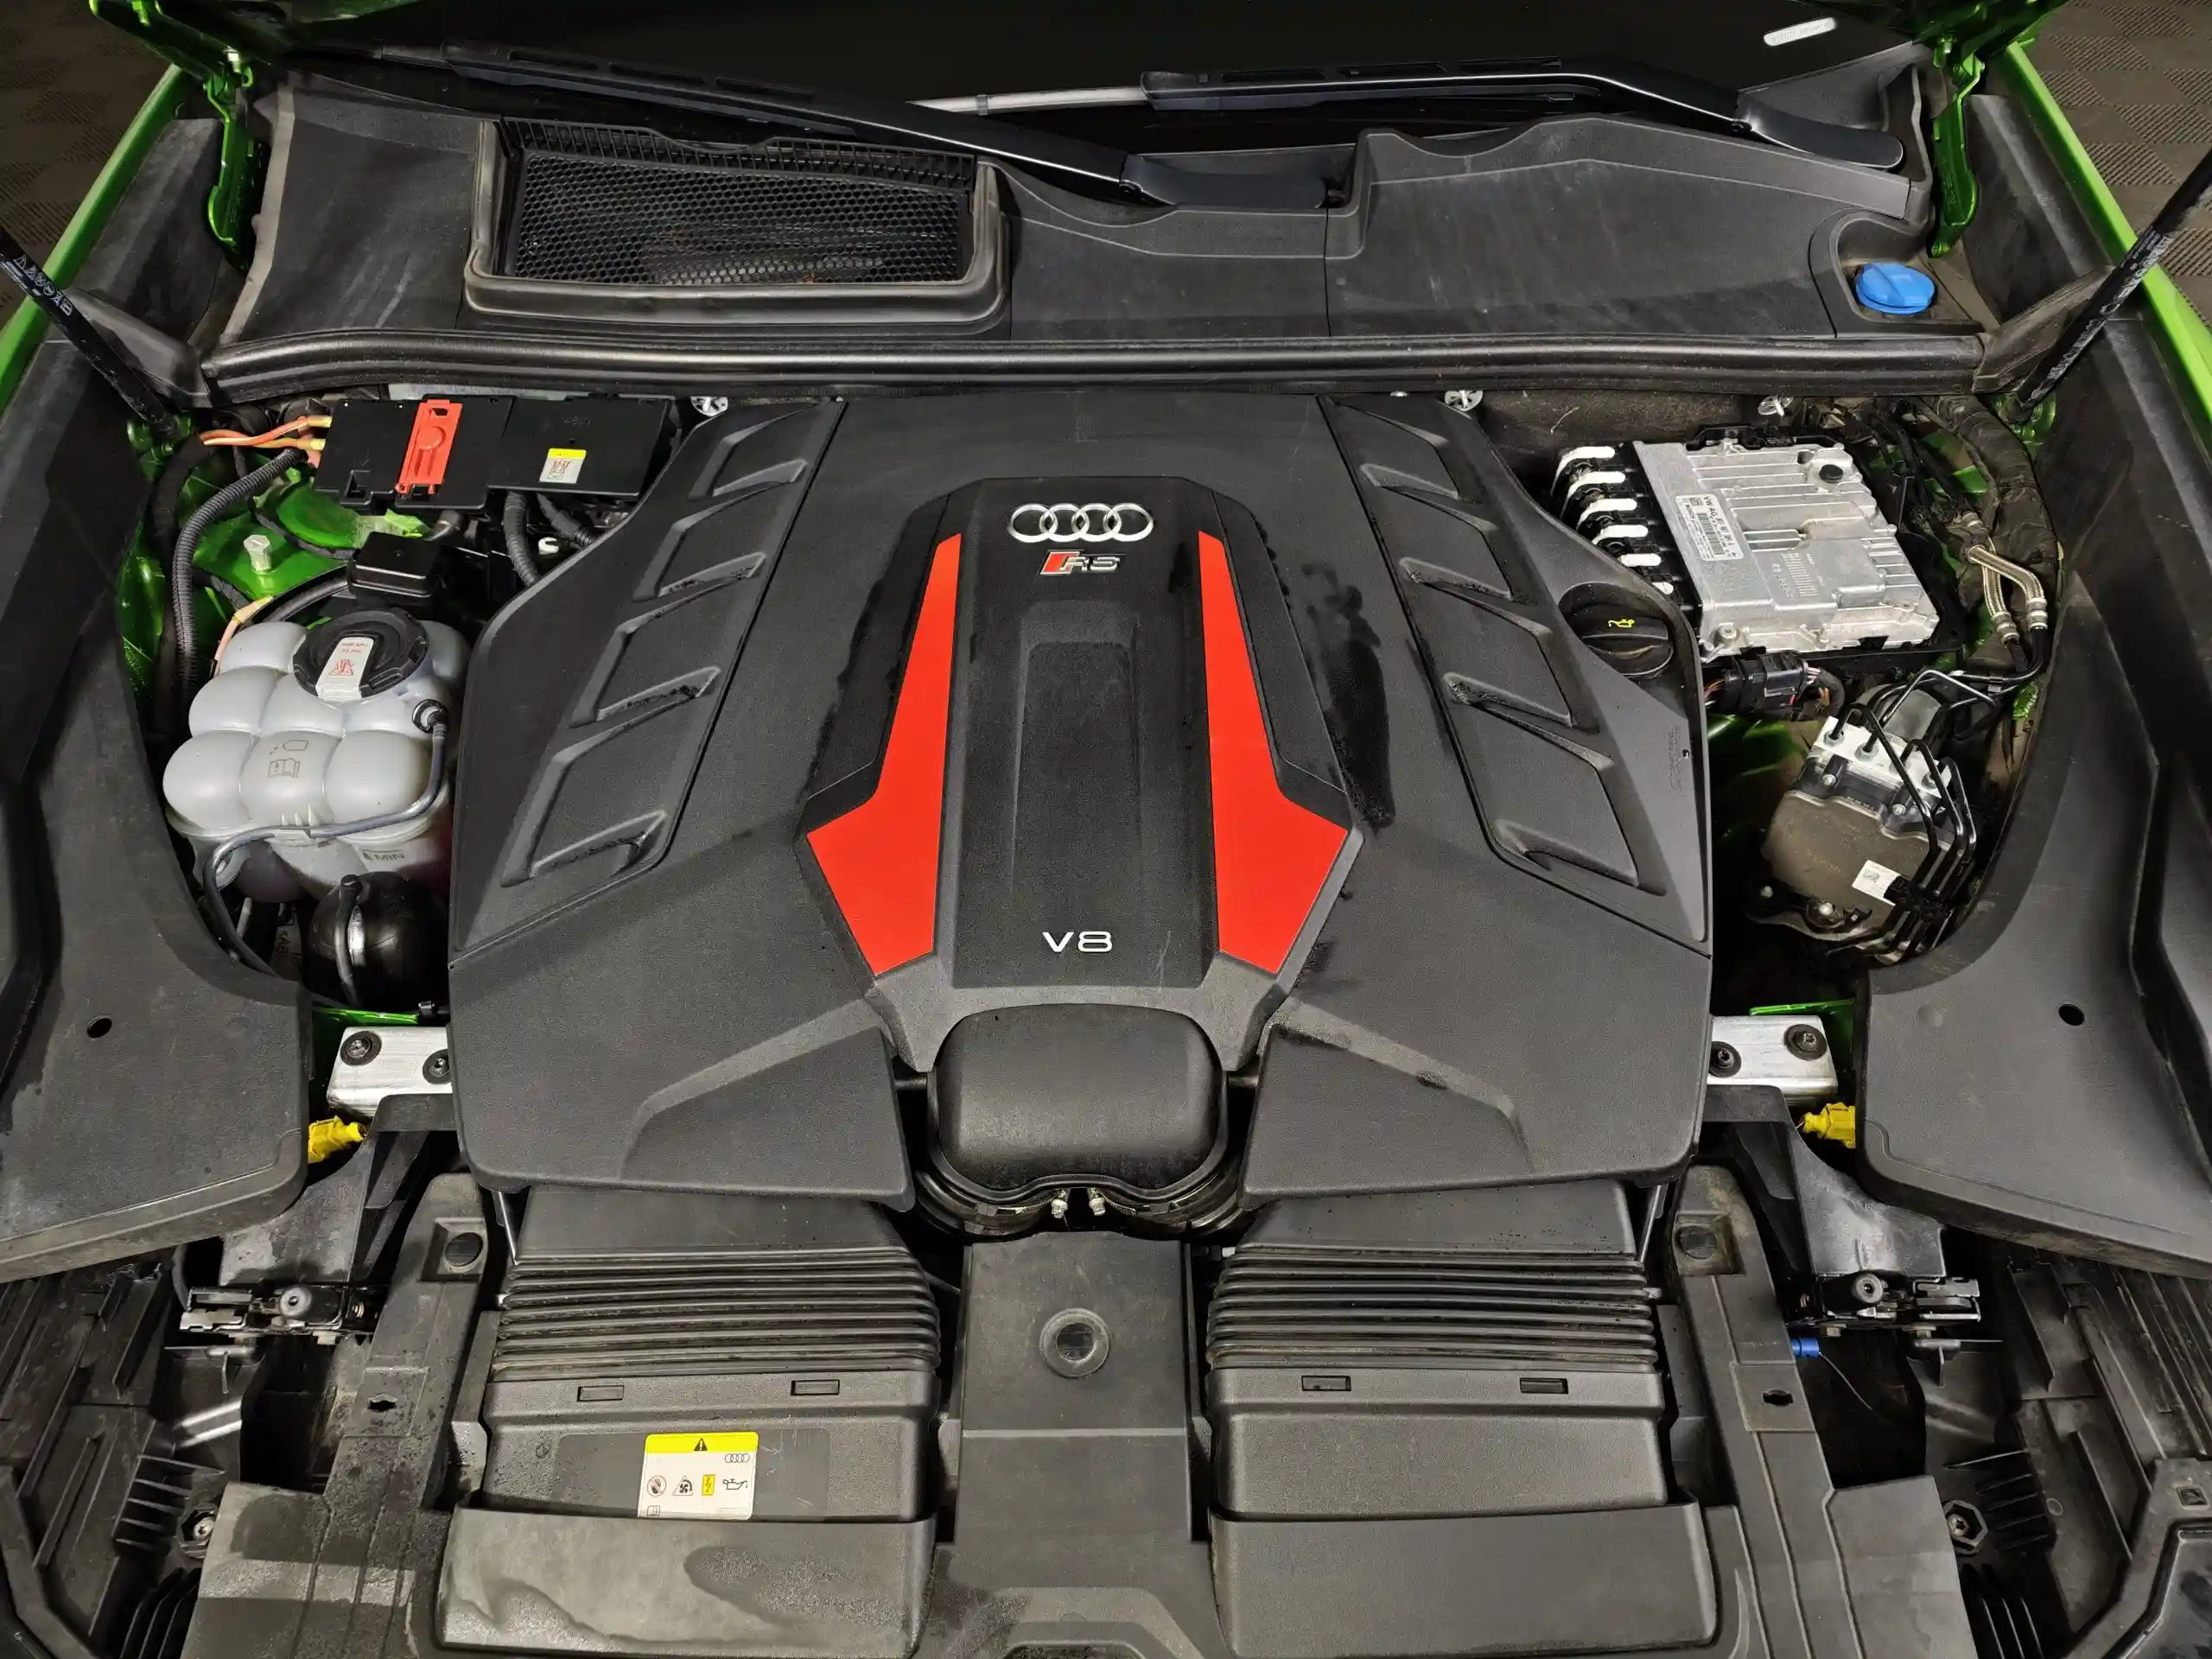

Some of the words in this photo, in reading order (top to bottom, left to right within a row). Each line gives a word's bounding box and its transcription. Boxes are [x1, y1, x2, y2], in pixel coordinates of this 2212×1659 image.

[1704, 496, 1713, 506] VW
[1043, 551, 1121, 574] RS
[1041, 931, 1113, 952] V8
